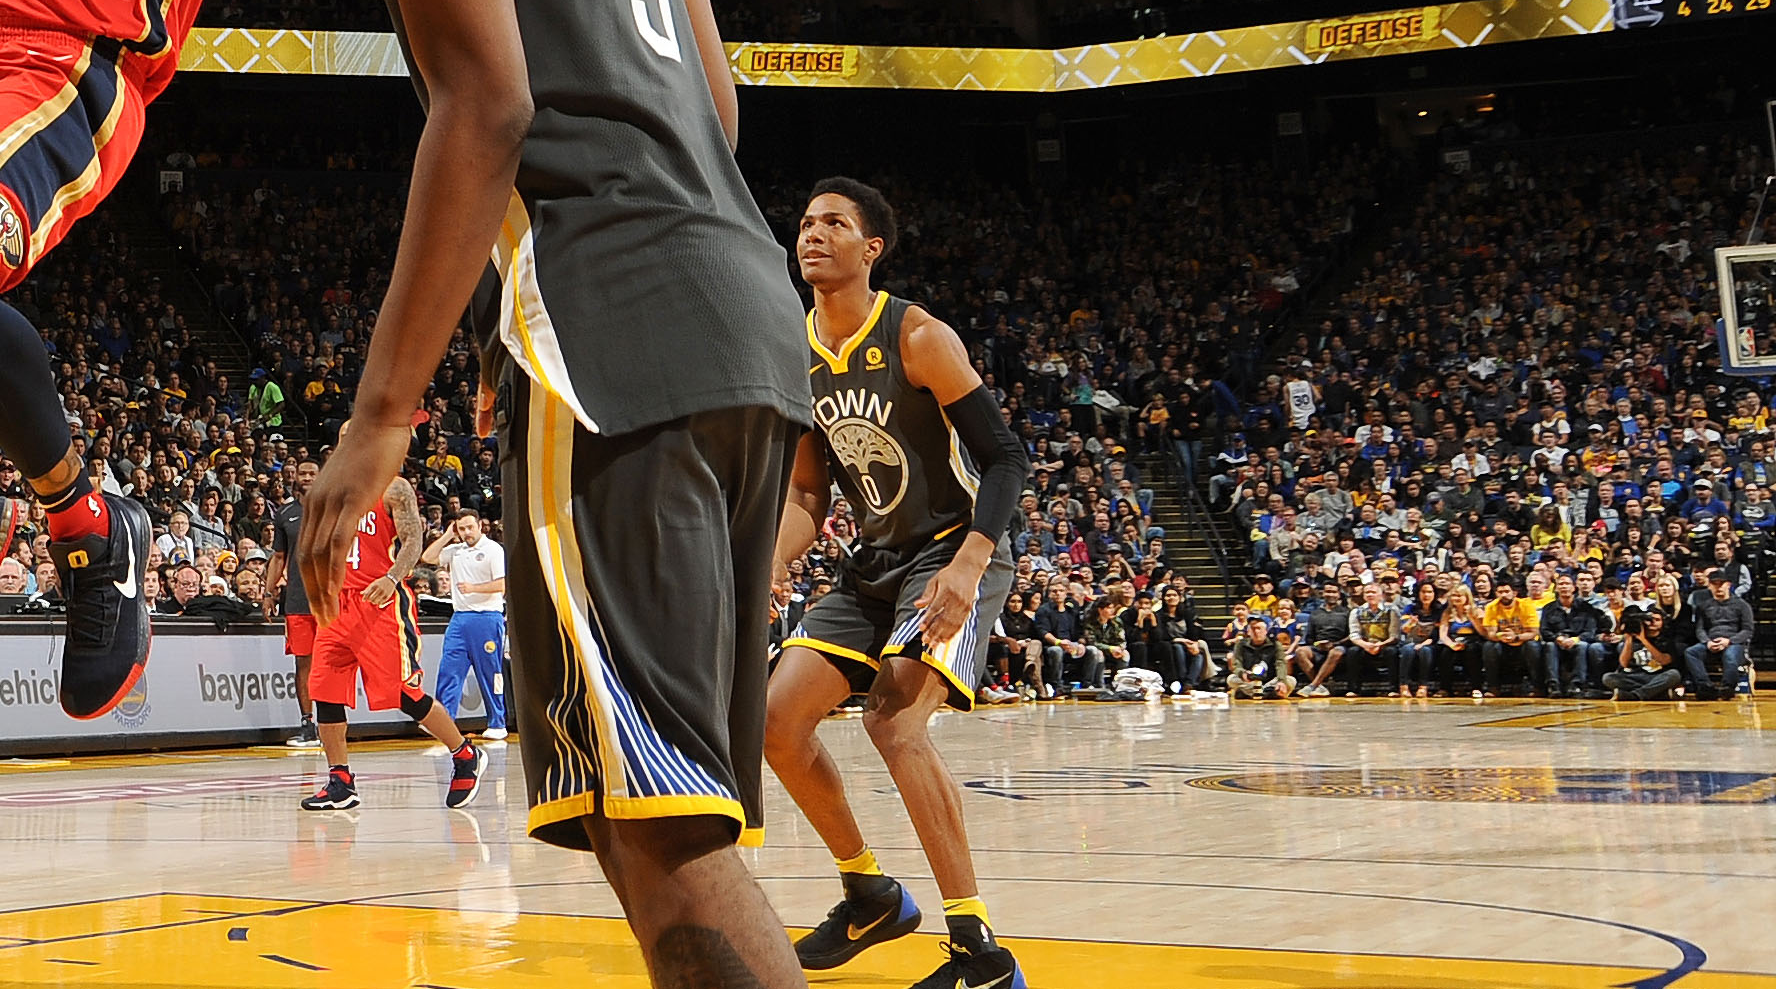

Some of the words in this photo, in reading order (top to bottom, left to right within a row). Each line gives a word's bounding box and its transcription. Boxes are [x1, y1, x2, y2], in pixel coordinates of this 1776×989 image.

[1677, 0, 1692, 17] 4
[1320, 15, 1423, 49] DEFENSE
[752, 50, 844, 73] DEFENSE
[1293, 394, 1310, 407] 30
[861, 474, 882, 507] 0
